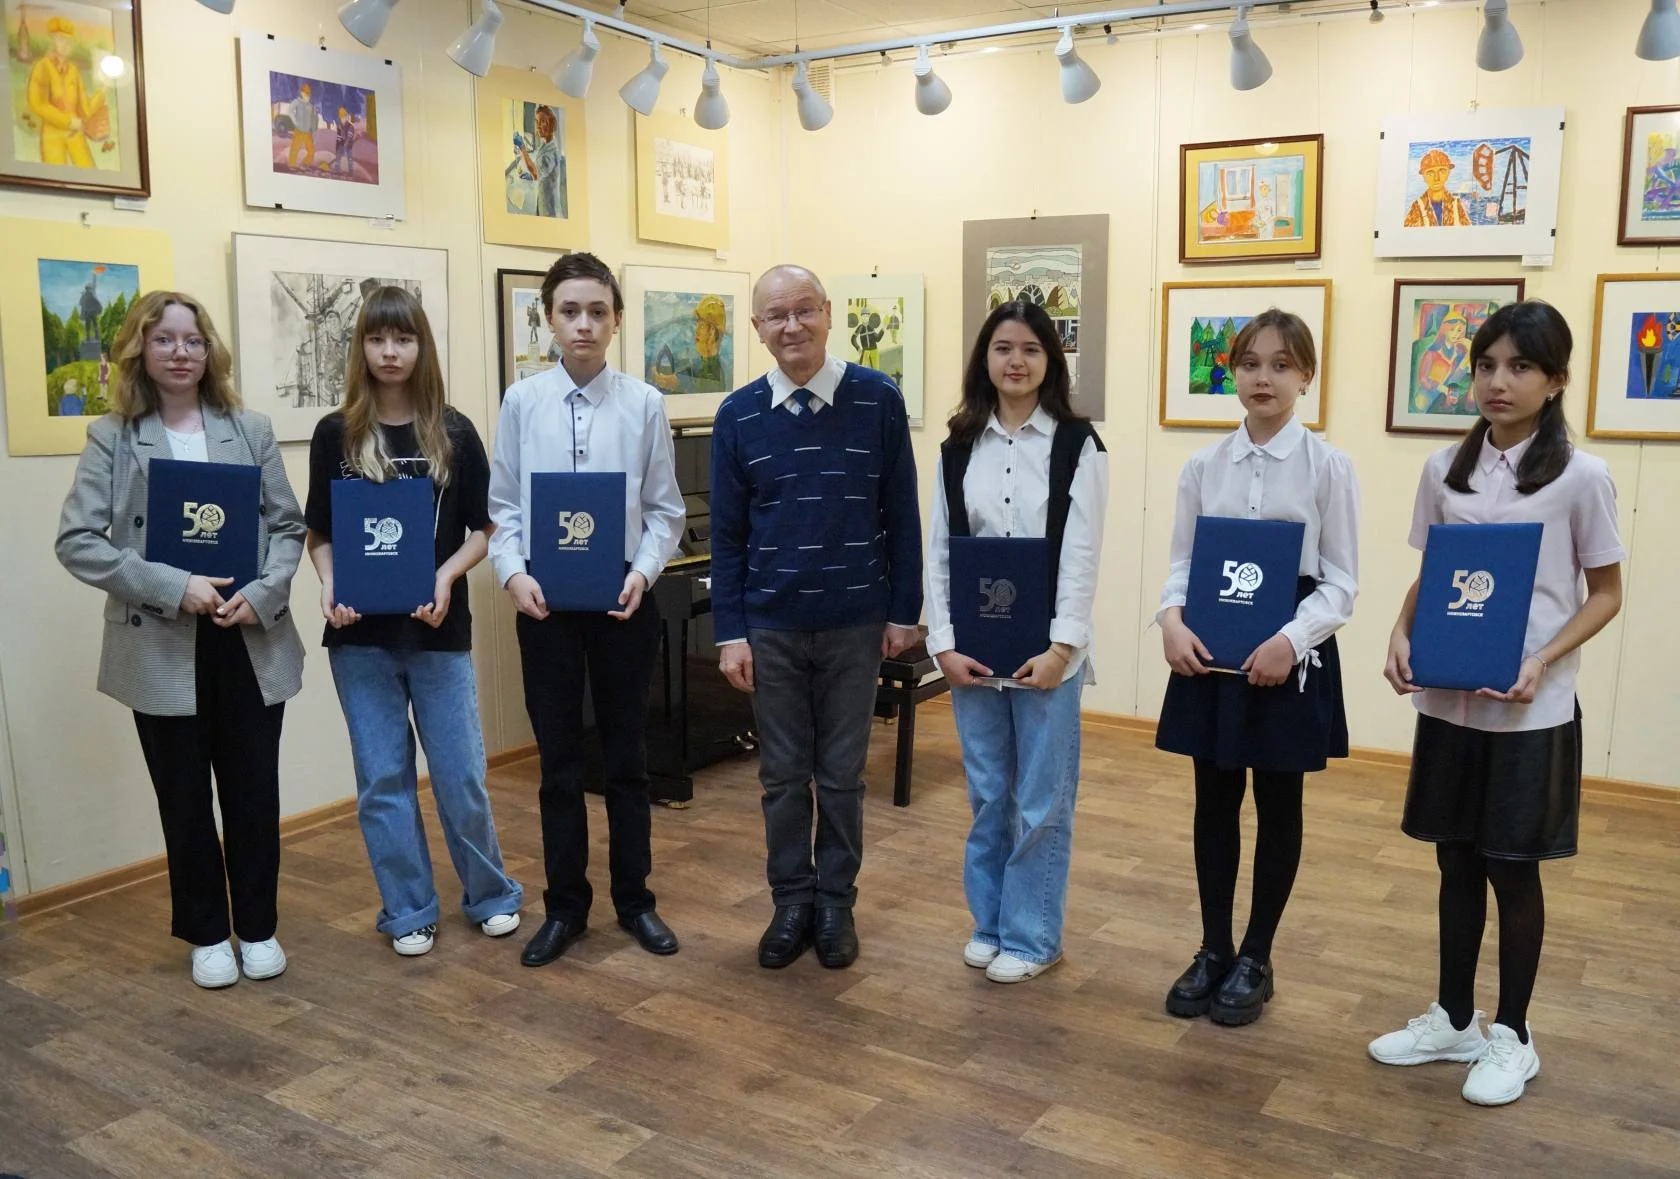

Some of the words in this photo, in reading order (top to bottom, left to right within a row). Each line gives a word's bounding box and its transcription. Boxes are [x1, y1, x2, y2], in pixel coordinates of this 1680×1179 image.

[183, 501, 225, 537] 50
[364, 517, 403, 551] 50
[559, 511, 594, 545] 50
[979, 577, 1017, 612] 50
[1220, 560, 1263, 597] 50
[1448, 569, 1495, 609] 50
